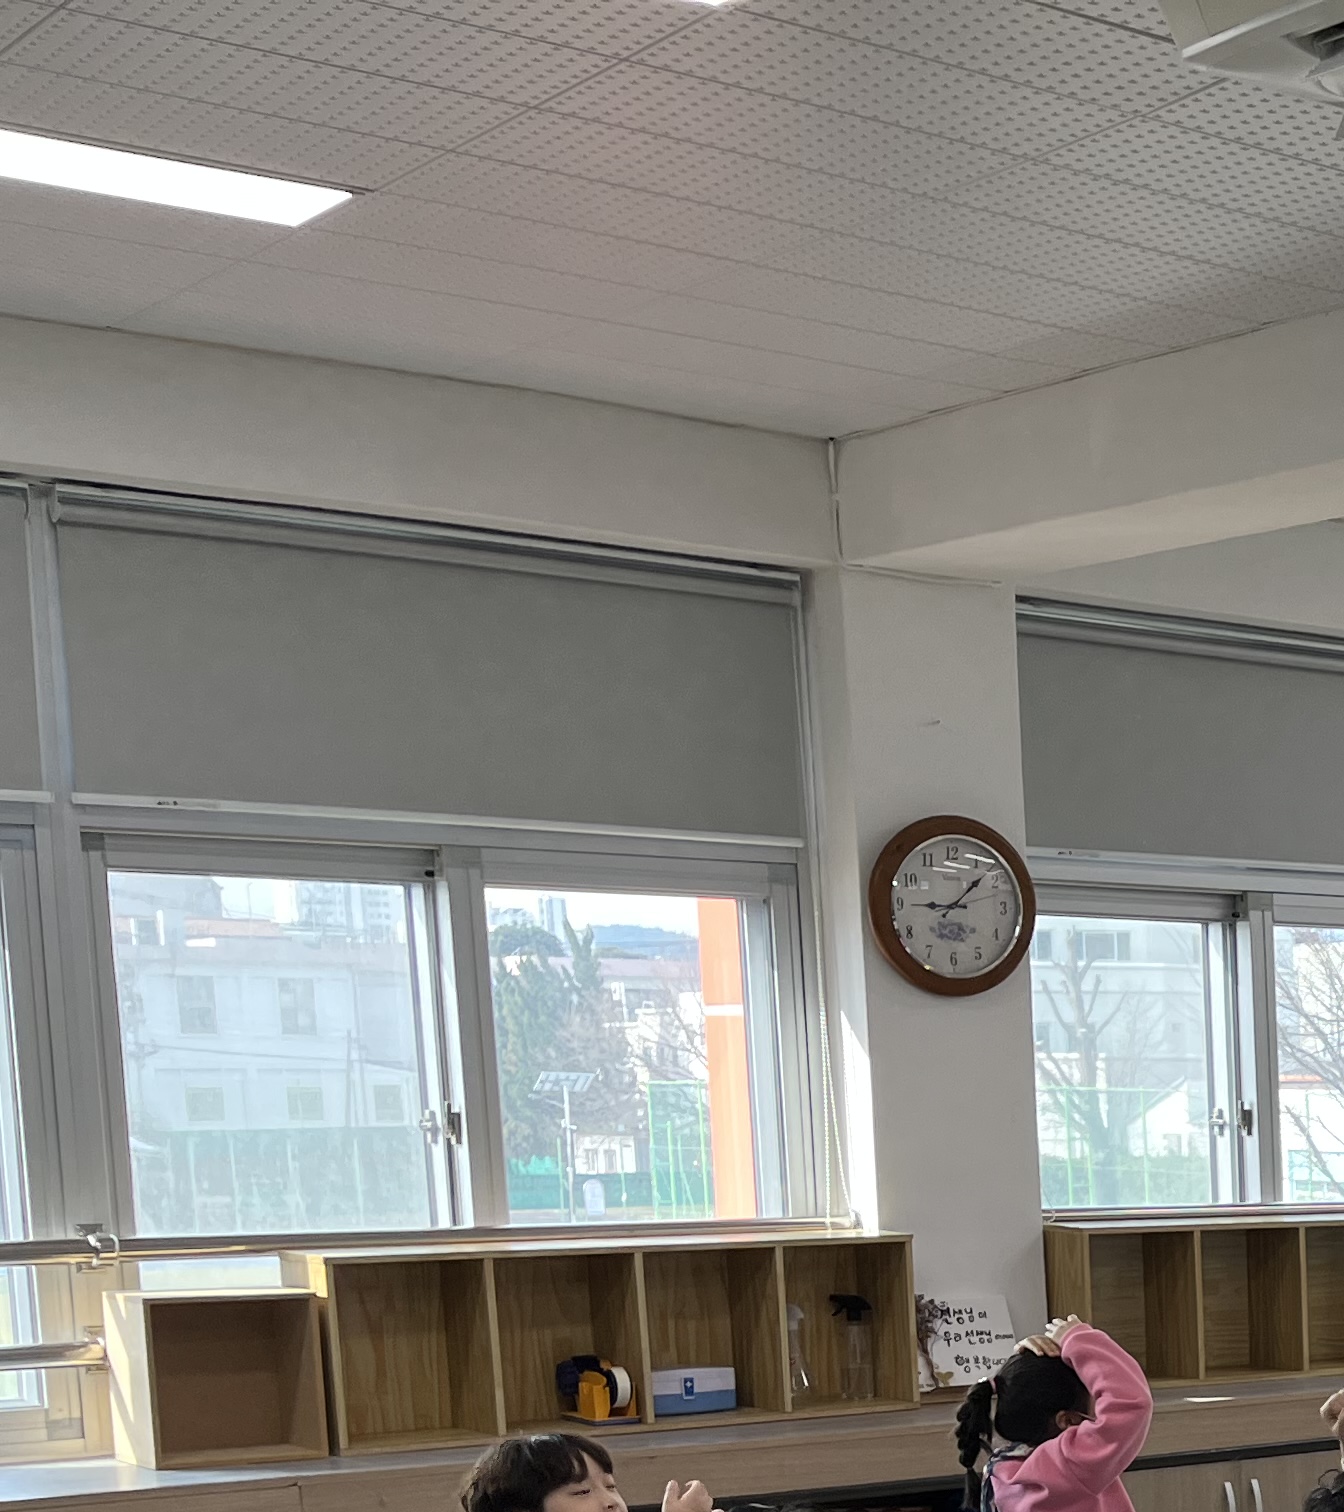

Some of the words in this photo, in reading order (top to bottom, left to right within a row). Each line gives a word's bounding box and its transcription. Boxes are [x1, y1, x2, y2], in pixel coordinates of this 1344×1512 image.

[921, 853, 934, 867] 11
[945, 845, 959, 861] 12
[903, 873, 918, 888] 10
[991, 874, 999, 889] 2
[896, 897, 904, 911] 9
[999, 901, 1007, 916] 3
[905, 926, 913, 940] 8
[991, 927, 999, 941] 4
[925, 945, 934, 959] 7
[949, 951, 958, 967] 6
[974, 946, 982, 961] 5
